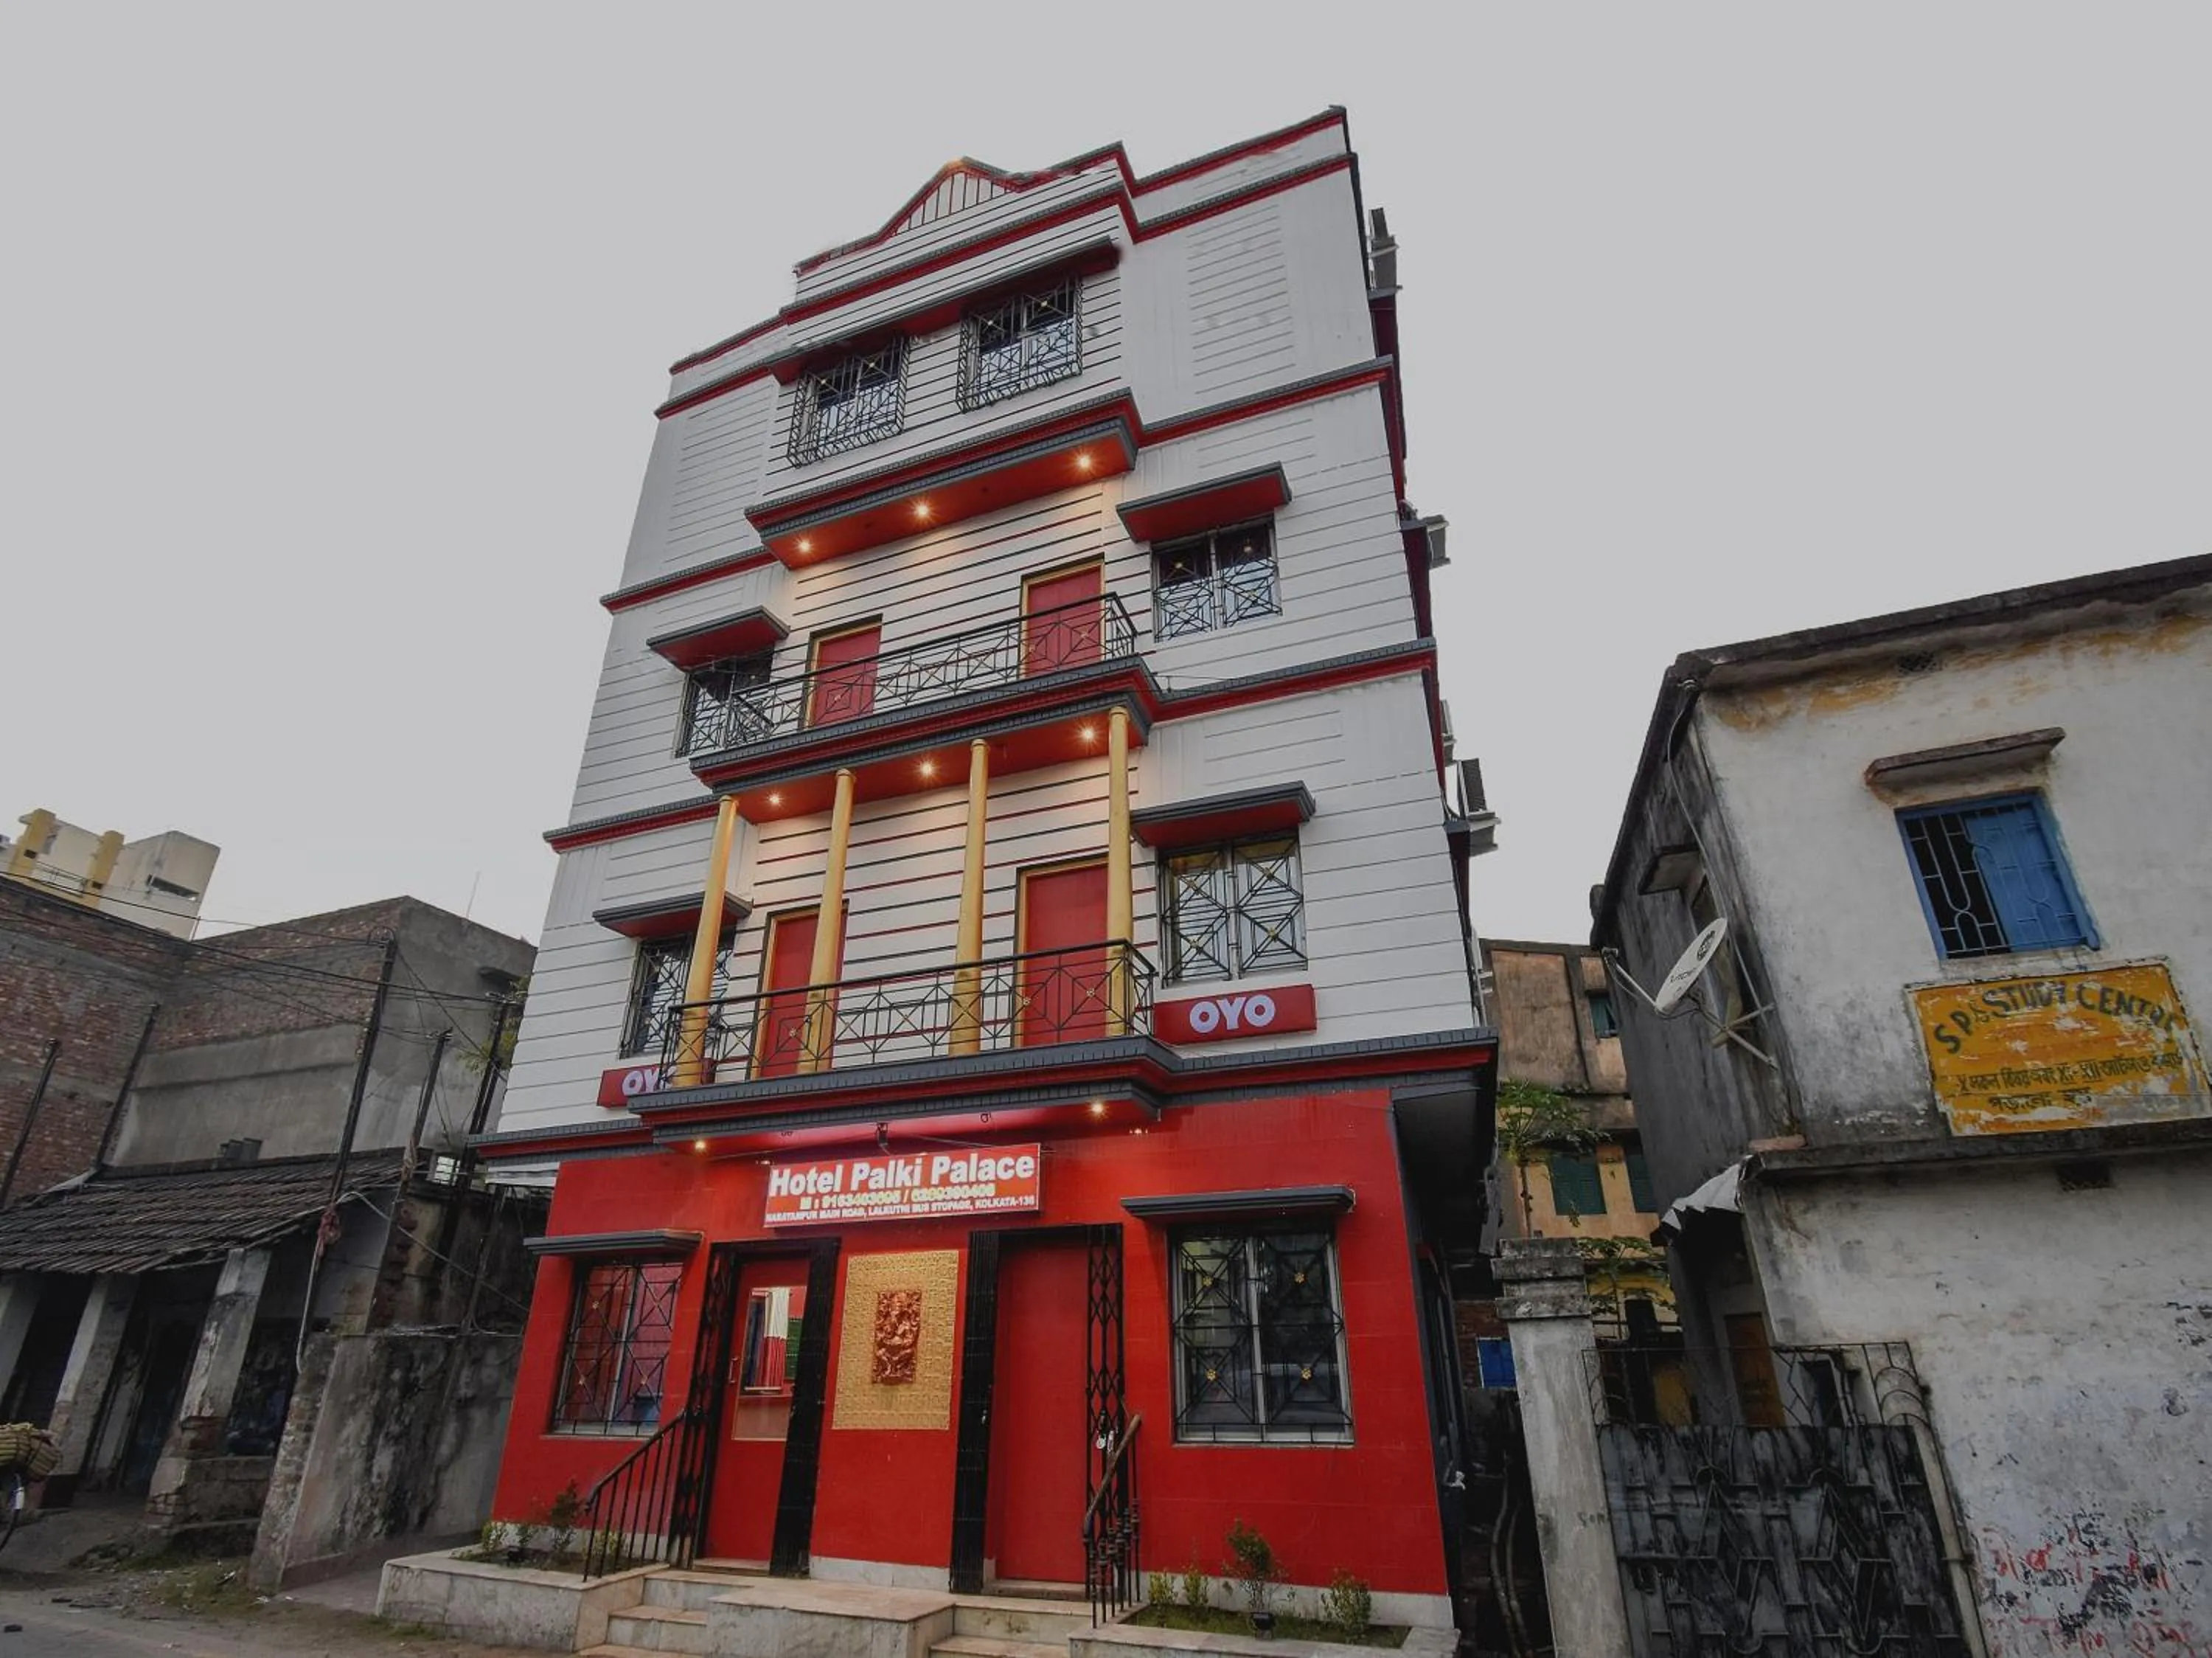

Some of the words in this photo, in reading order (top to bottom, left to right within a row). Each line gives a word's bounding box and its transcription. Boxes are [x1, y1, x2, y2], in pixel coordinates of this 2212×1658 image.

[1189, 995, 1276, 1033] OYO
[768, 1165, 843, 1196] Hotel
[850, 1158, 922, 1190] Palki
[931, 1153, 1034, 1184] Palace
